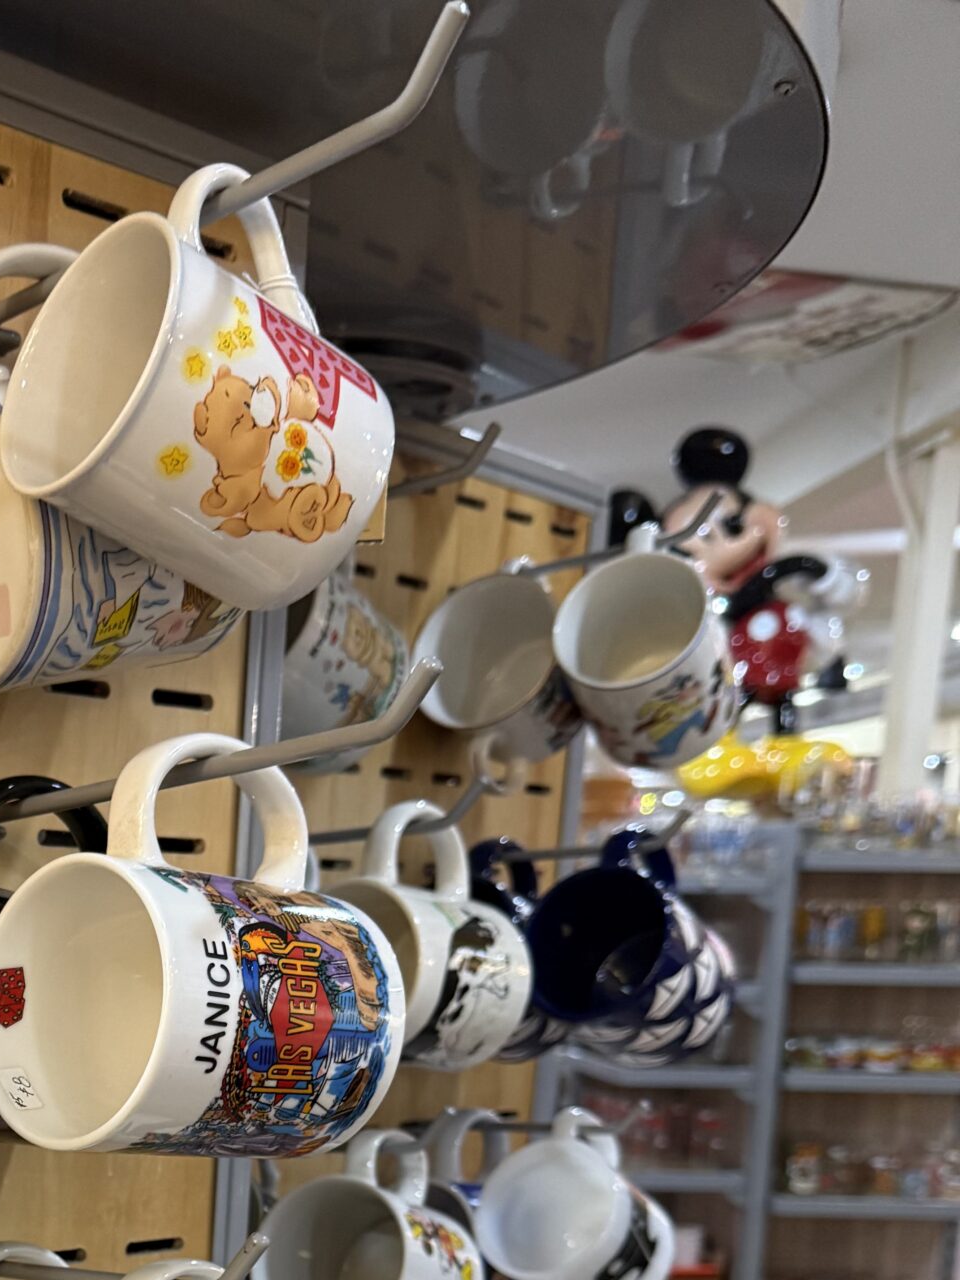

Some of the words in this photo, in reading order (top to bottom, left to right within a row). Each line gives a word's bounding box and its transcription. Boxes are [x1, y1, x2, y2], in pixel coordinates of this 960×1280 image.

[195, 938, 230, 1074] JANICE
[262, 936, 322, 1036] VEGAS
[251, 1045, 313, 1095] LAS
